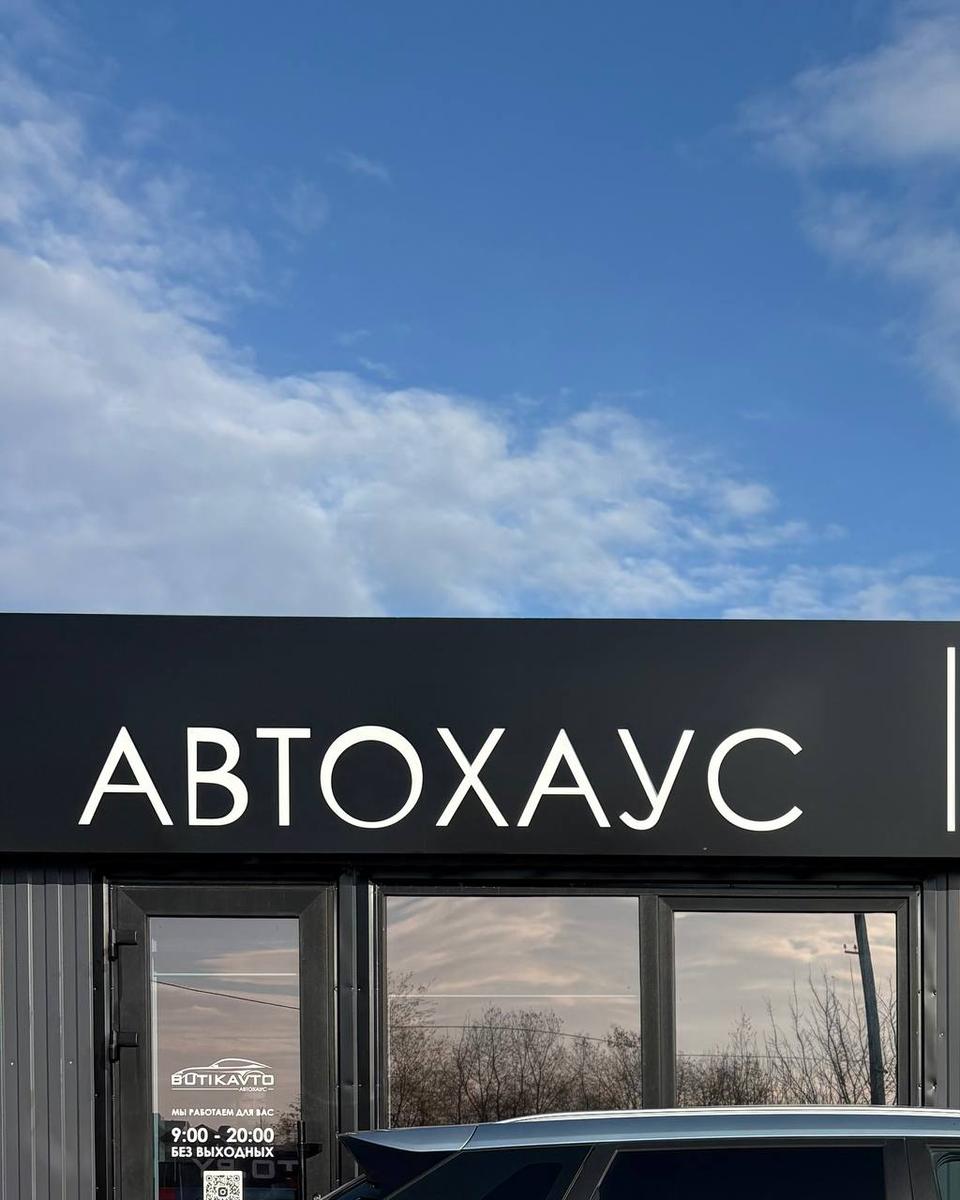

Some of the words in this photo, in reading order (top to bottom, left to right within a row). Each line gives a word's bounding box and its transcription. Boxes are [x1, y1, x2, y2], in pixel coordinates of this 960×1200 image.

[78, 724, 803, 832] АВТОХАУС
[171, 1074, 274, 1086] BUTIKAVTO
[236, 1109, 253, 1117] ДЛЯ
[171, 1127, 208, 1143] 9:00
[226, 1127, 275, 1143] 20:00
[171, 1146, 193, 1158] БЕЗ
[196, 1146, 274, 1159] ВЫХОДНЫХ
